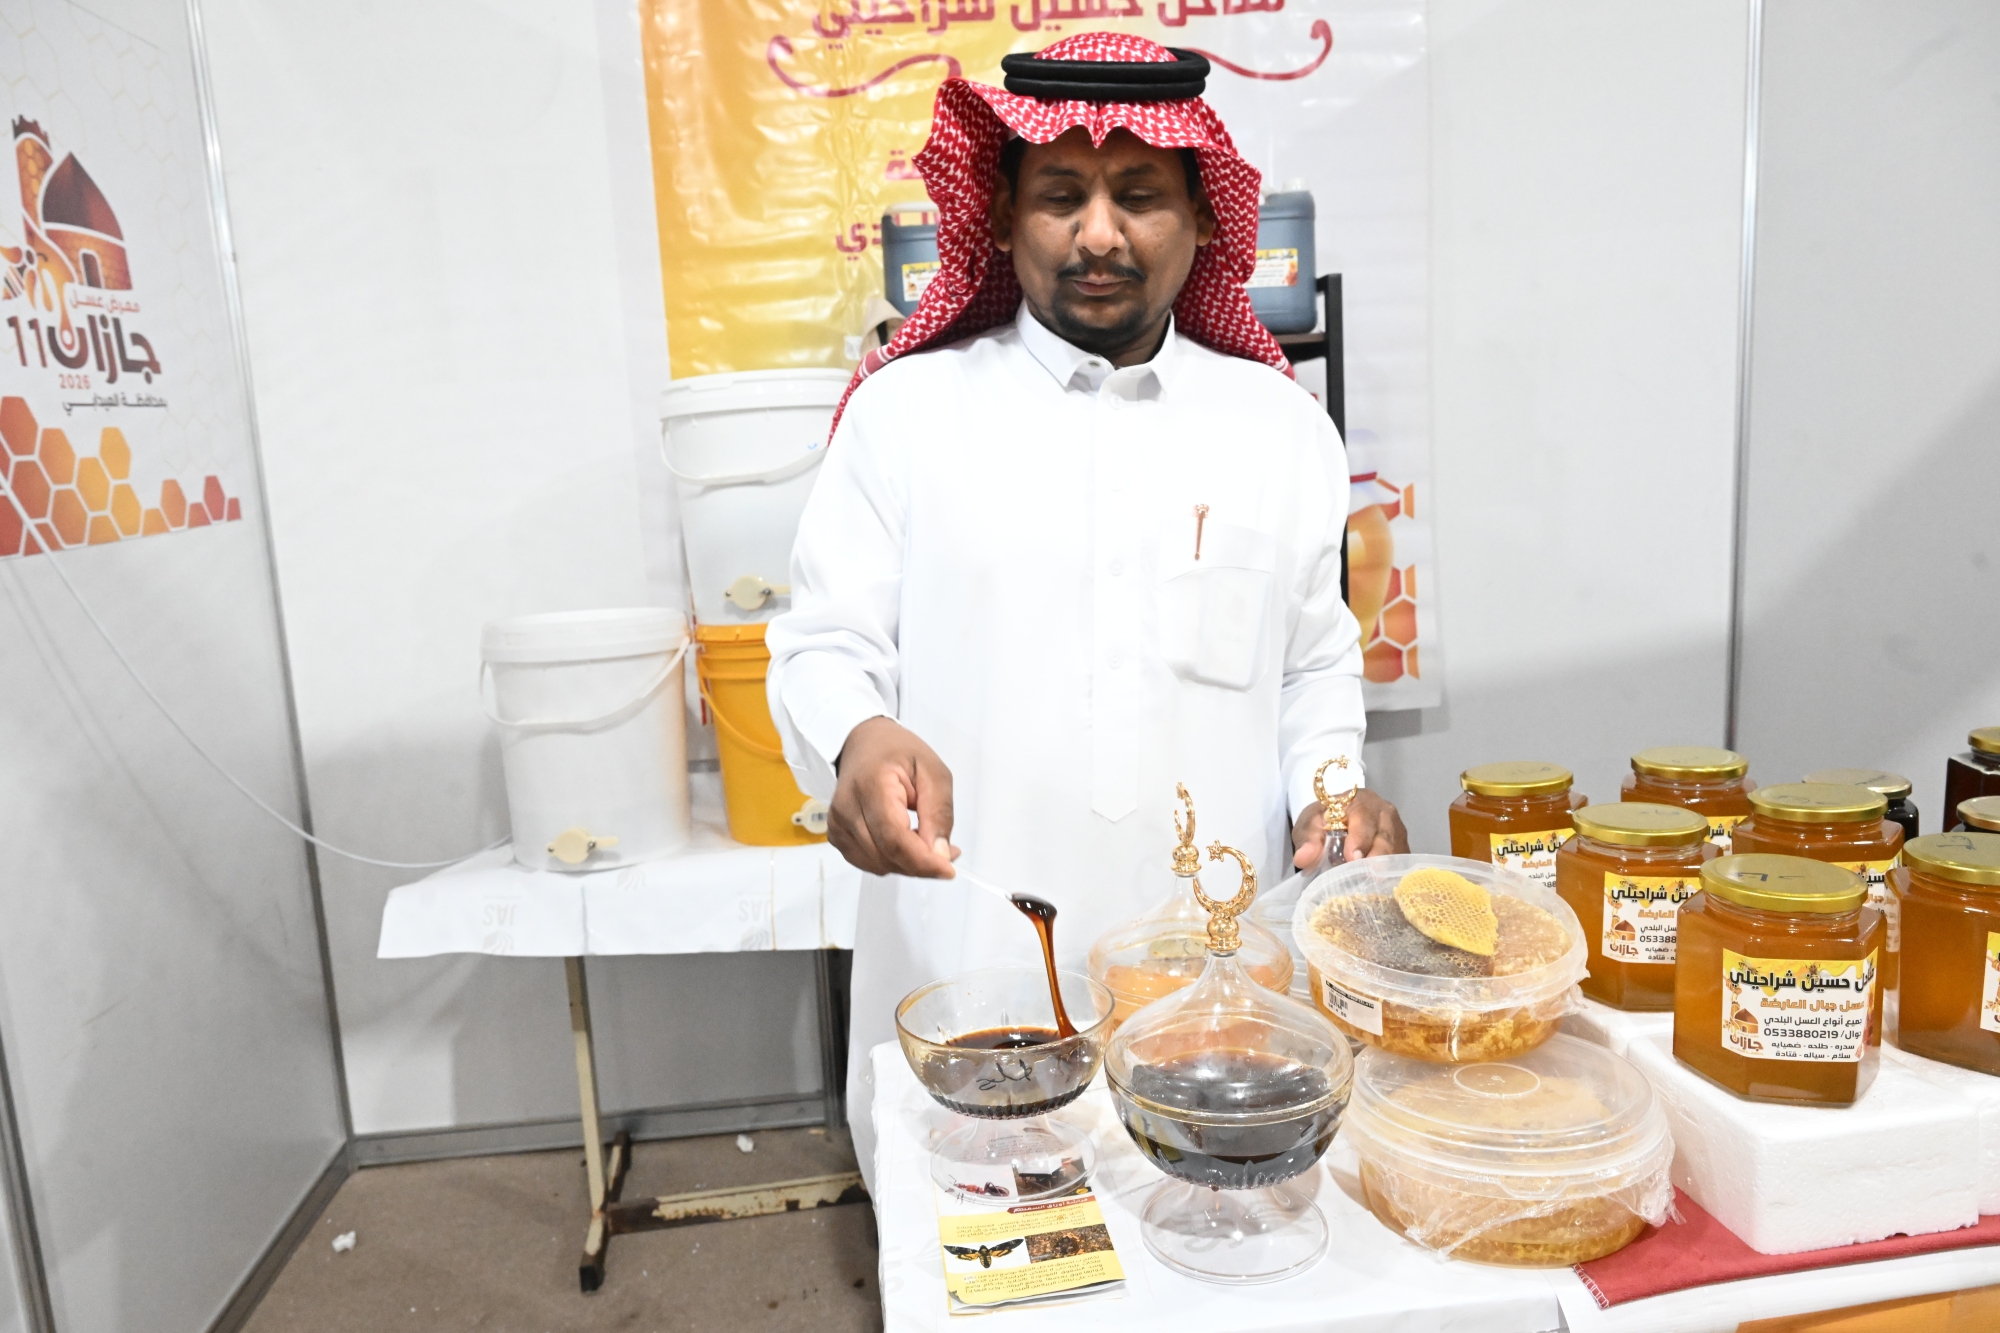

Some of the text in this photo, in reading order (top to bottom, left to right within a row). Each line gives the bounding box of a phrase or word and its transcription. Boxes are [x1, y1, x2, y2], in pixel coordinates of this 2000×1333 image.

[47, 314, 161, 384] جازان
[59, 373, 91, 389] 2026
[1497, 839, 1543, 859] شراحيلي
[1612, 885, 1667, 903] شراحيلي
[1638, 909, 1675, 920] العارضة
[1640, 935, 1676, 943] 053388
[1730, 970, 1796, 991] شراحيلي
[1802, 973, 1850, 992] حسين
[1760, 998, 1806, 1010] العارضة
[1810, 999, 1837, 1012] جبال
[1764, 1016, 1792, 1026] البلدي
[1795, 1017, 1820, 1026] العسل
[1823, 1014, 1843, 1027] أنواع
[1764, 1028, 1838, 1038] 0533880219
[1730, 1034, 1764, 1052] جازان
